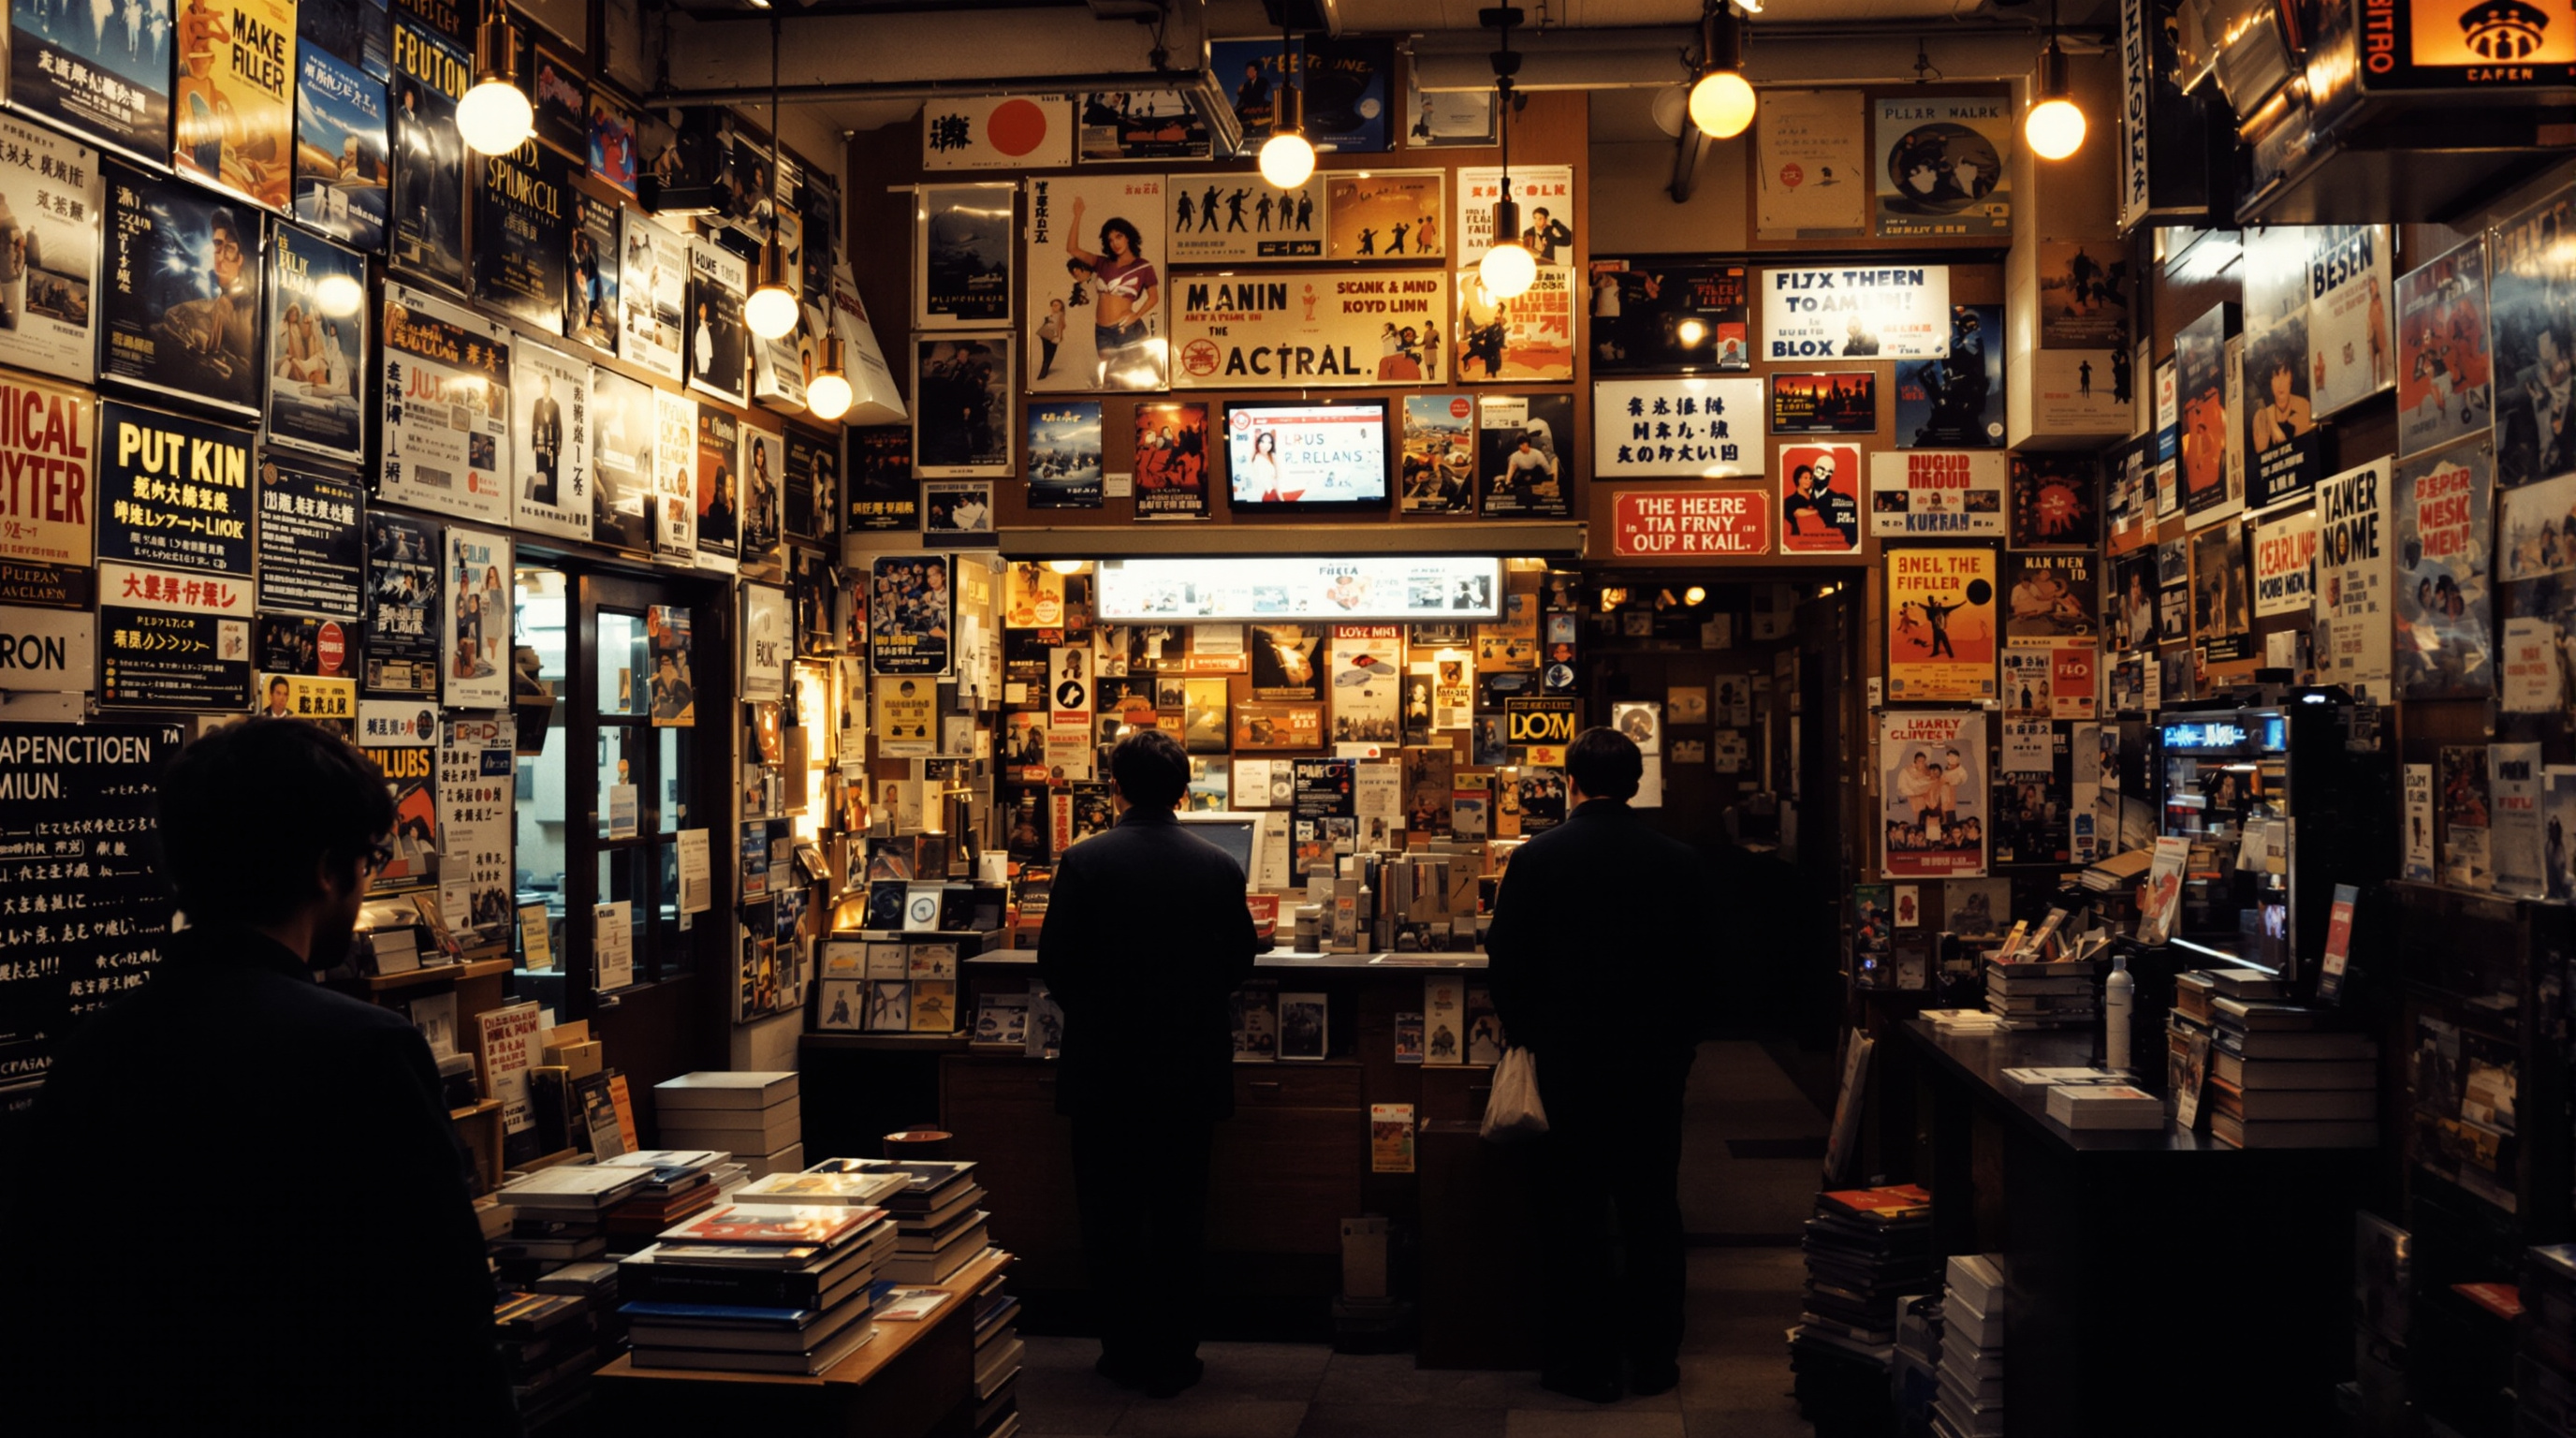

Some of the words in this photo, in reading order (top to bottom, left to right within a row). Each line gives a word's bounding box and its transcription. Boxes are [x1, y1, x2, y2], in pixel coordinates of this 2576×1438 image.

[233, 7, 286, 66] MAKE
[232, 42, 285, 98] FILLER
[2314, 228, 2374, 300] BESEN
[1186, 283, 1288, 312] MANIN
[1784, 296, 1819, 314] TO
[1771, 340, 1836, 358] BLOX
[118, 421, 185, 477] PUT
[190, 437, 246, 489] KIN
[1635, 497, 1676, 517] THE
[1681, 497, 1749, 516] HEERE
[1632, 535, 1677, 553] OUP
[1682, 534, 1699, 551] R
[2322, 512, 2379, 569] NOME
[1948, 556, 1983, 574] THE
